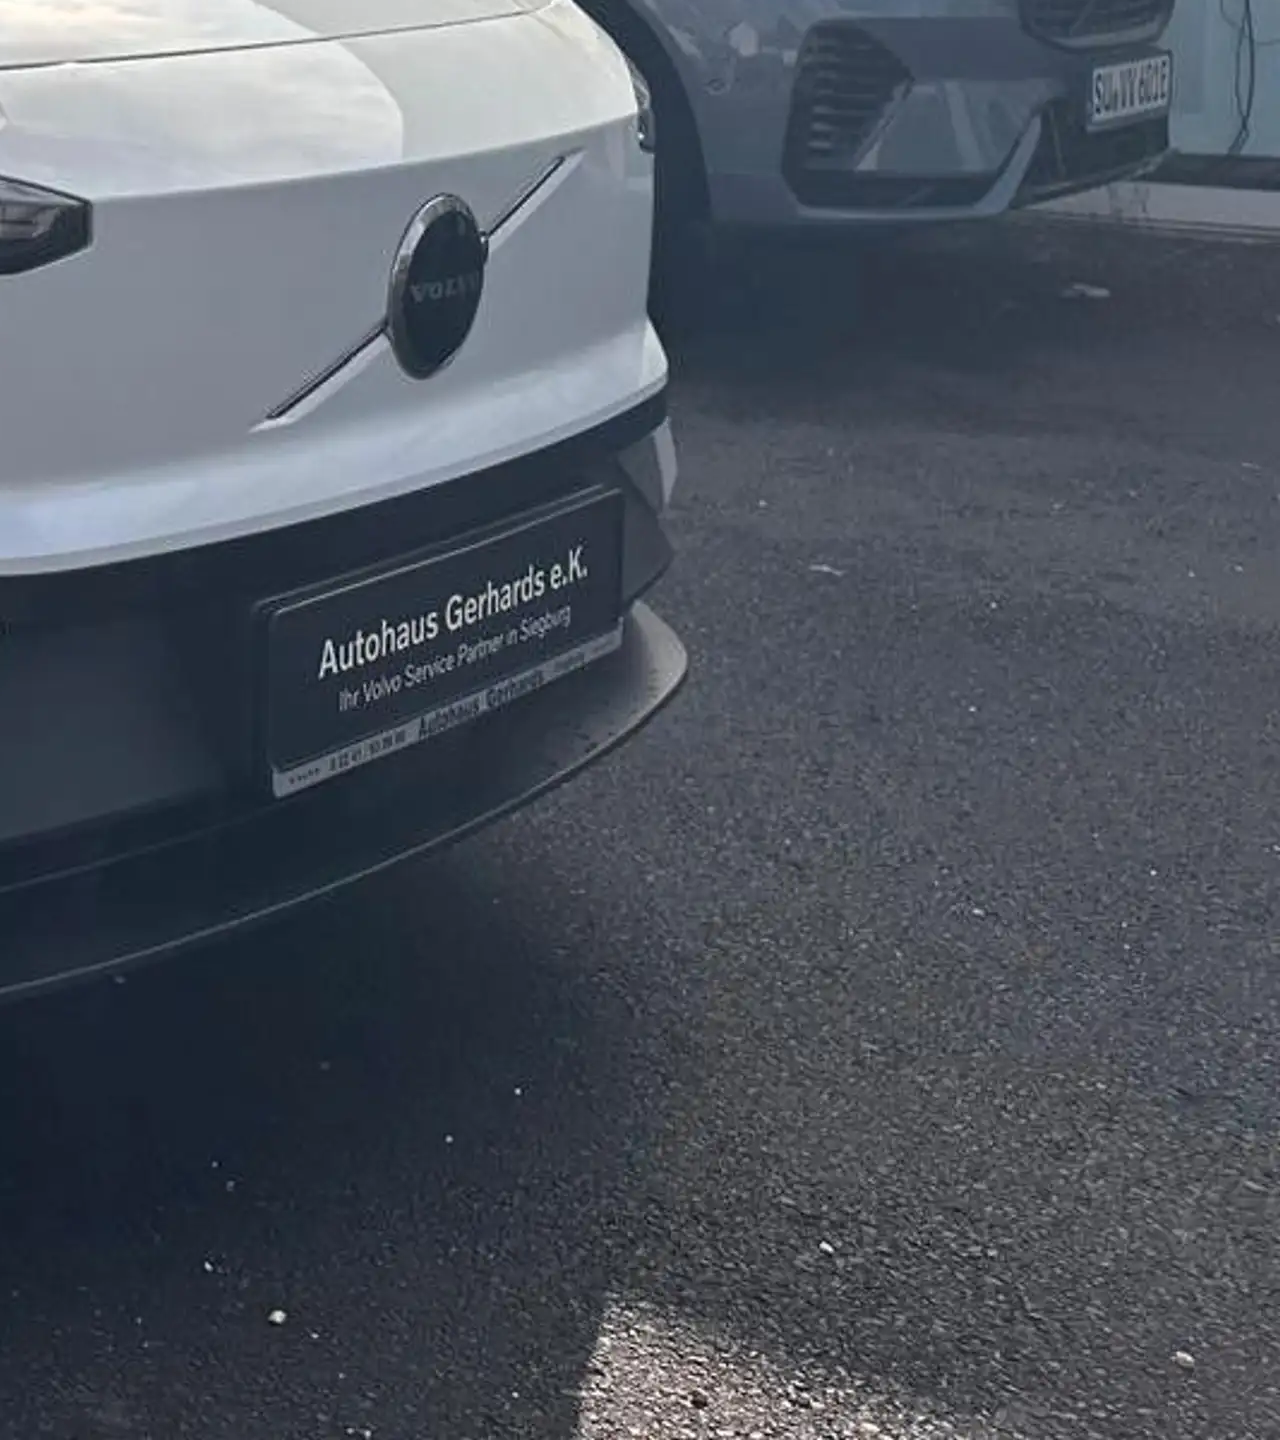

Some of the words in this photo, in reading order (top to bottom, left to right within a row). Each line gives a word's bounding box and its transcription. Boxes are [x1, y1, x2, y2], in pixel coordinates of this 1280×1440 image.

[318, 611, 439, 679] Autohaus
[445, 564, 545, 631] Gerhards
[550, 545, 589, 590] e.K.
[339, 688, 359, 711] Ihr
[362, 670, 400, 703] Volvo
[404, 651, 456, 687] Service
[457, 634, 503, 667] Partner
[506, 630, 518, 645] in
[520, 605, 571, 640] Siegburg
